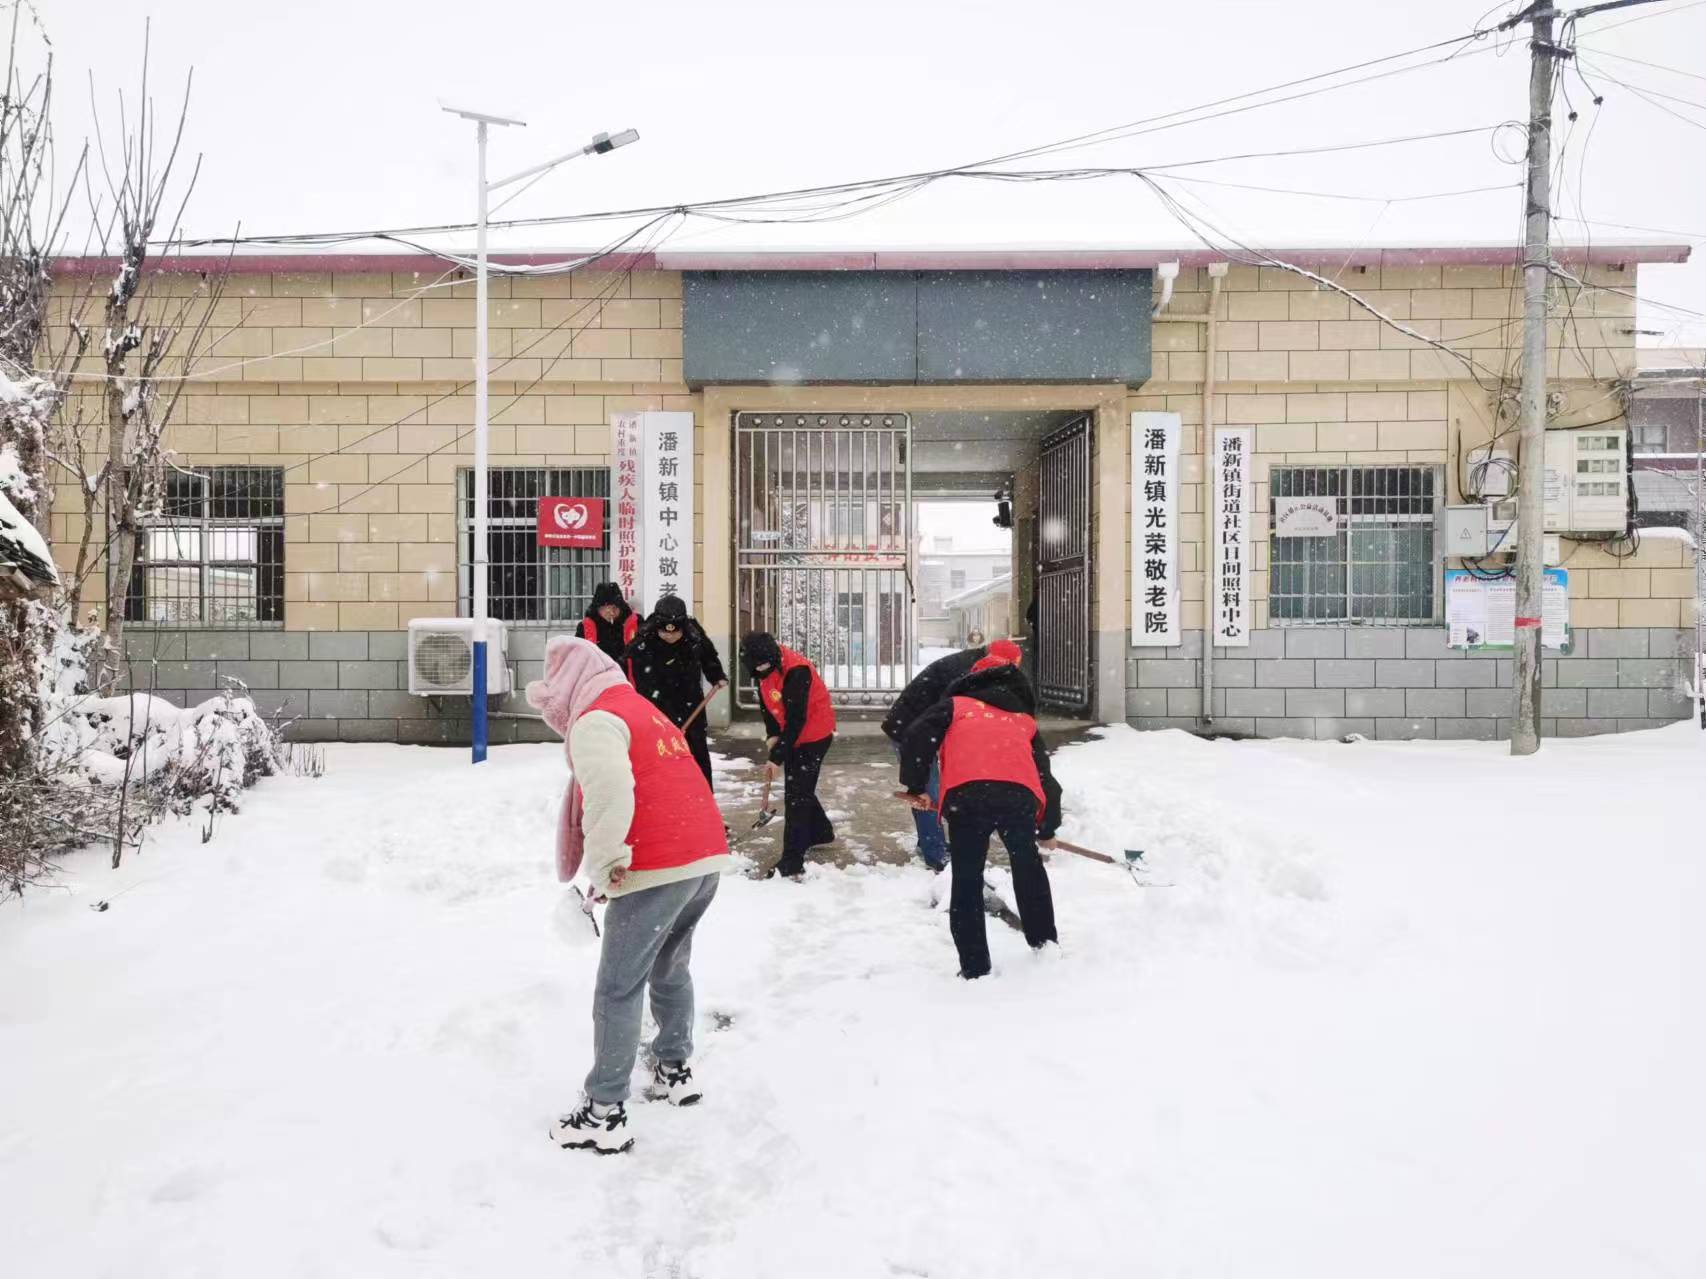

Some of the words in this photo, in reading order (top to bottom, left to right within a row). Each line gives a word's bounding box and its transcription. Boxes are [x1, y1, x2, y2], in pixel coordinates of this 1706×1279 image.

[1144, 428, 1168, 634] 潘新镇光荣敬老院
[1221, 437, 1242, 638] 潘新镇街道社区日间照料中心
